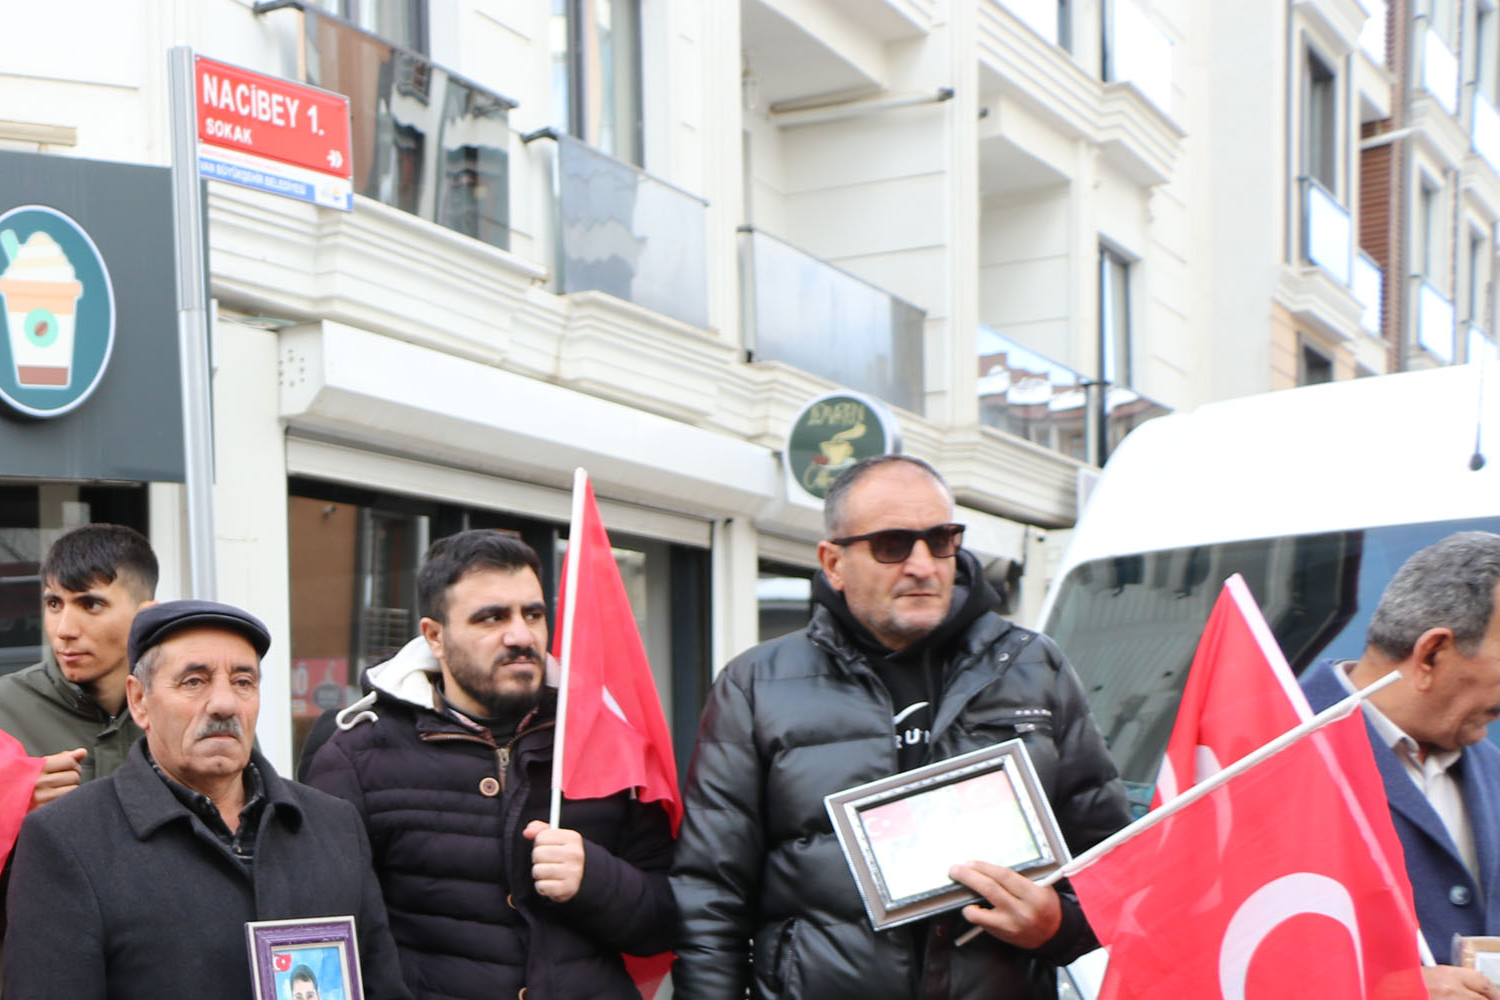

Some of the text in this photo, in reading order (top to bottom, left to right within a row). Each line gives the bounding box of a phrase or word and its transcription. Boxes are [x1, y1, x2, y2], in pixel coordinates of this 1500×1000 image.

[202, 73, 325, 136] NACİBEY 1.
[205, 117, 253, 145] SOKAK
